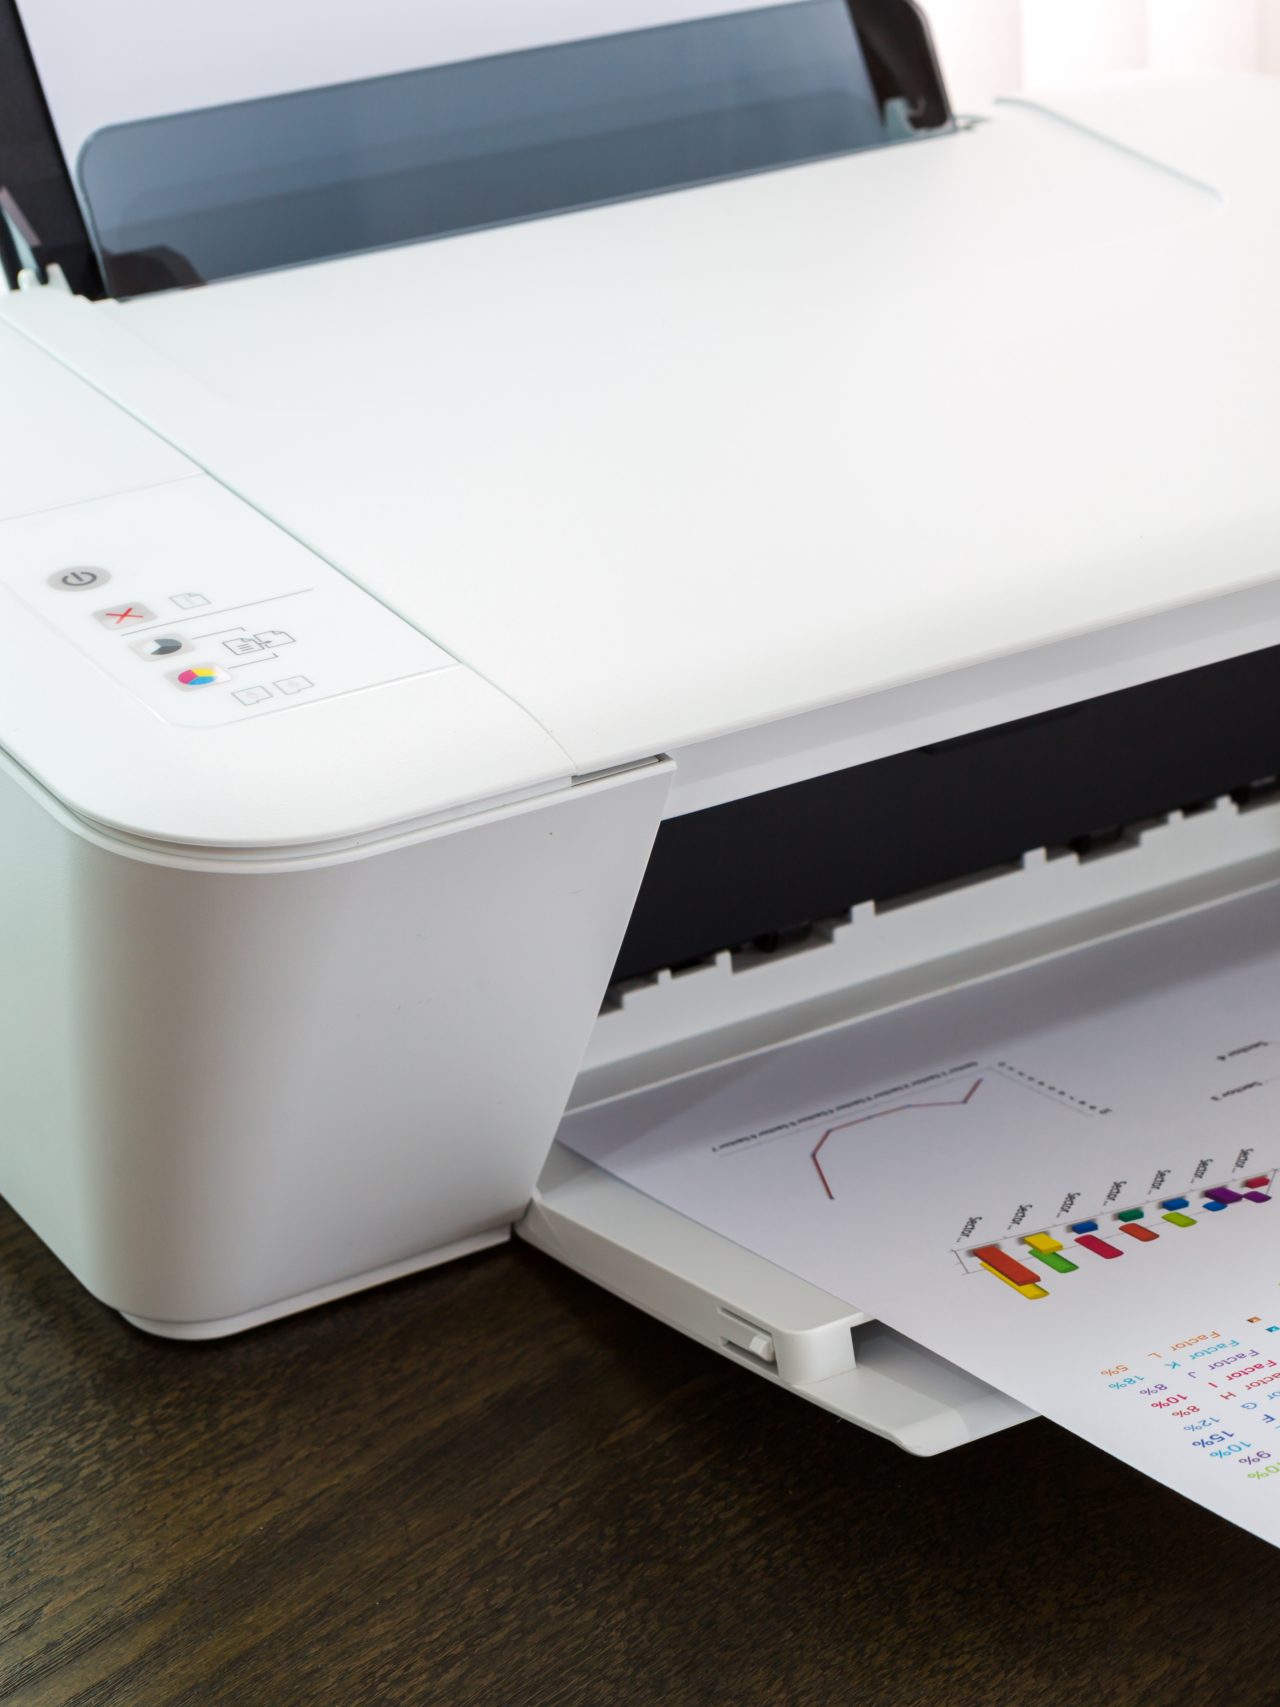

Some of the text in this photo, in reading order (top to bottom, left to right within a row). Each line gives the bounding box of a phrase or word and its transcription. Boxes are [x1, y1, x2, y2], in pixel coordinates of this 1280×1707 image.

[1171, 1331, 1221, 1351] Factor
[1101, 1365, 1128, 1376] 5%
[1108, 1340, 1239, 1389] Factor K 18%
[1140, 1350, 1259, 1395] Factor J 8%
[1151, 1360, 1277, 1408] Factor I 10%
[1219, 1391, 1237, 1401] H
[1172, 1406, 1200, 1417] 8%
[1240, 1402, 1258, 1410] G
[1184, 1418, 1219, 1432] 12%
[1262, 1413, 1276, 1424] F
[1192, 1431, 1234, 1448] 15%
[1210, 1442, 1251, 1458] 10%
[1239, 1451, 1271, 1465] 9%
